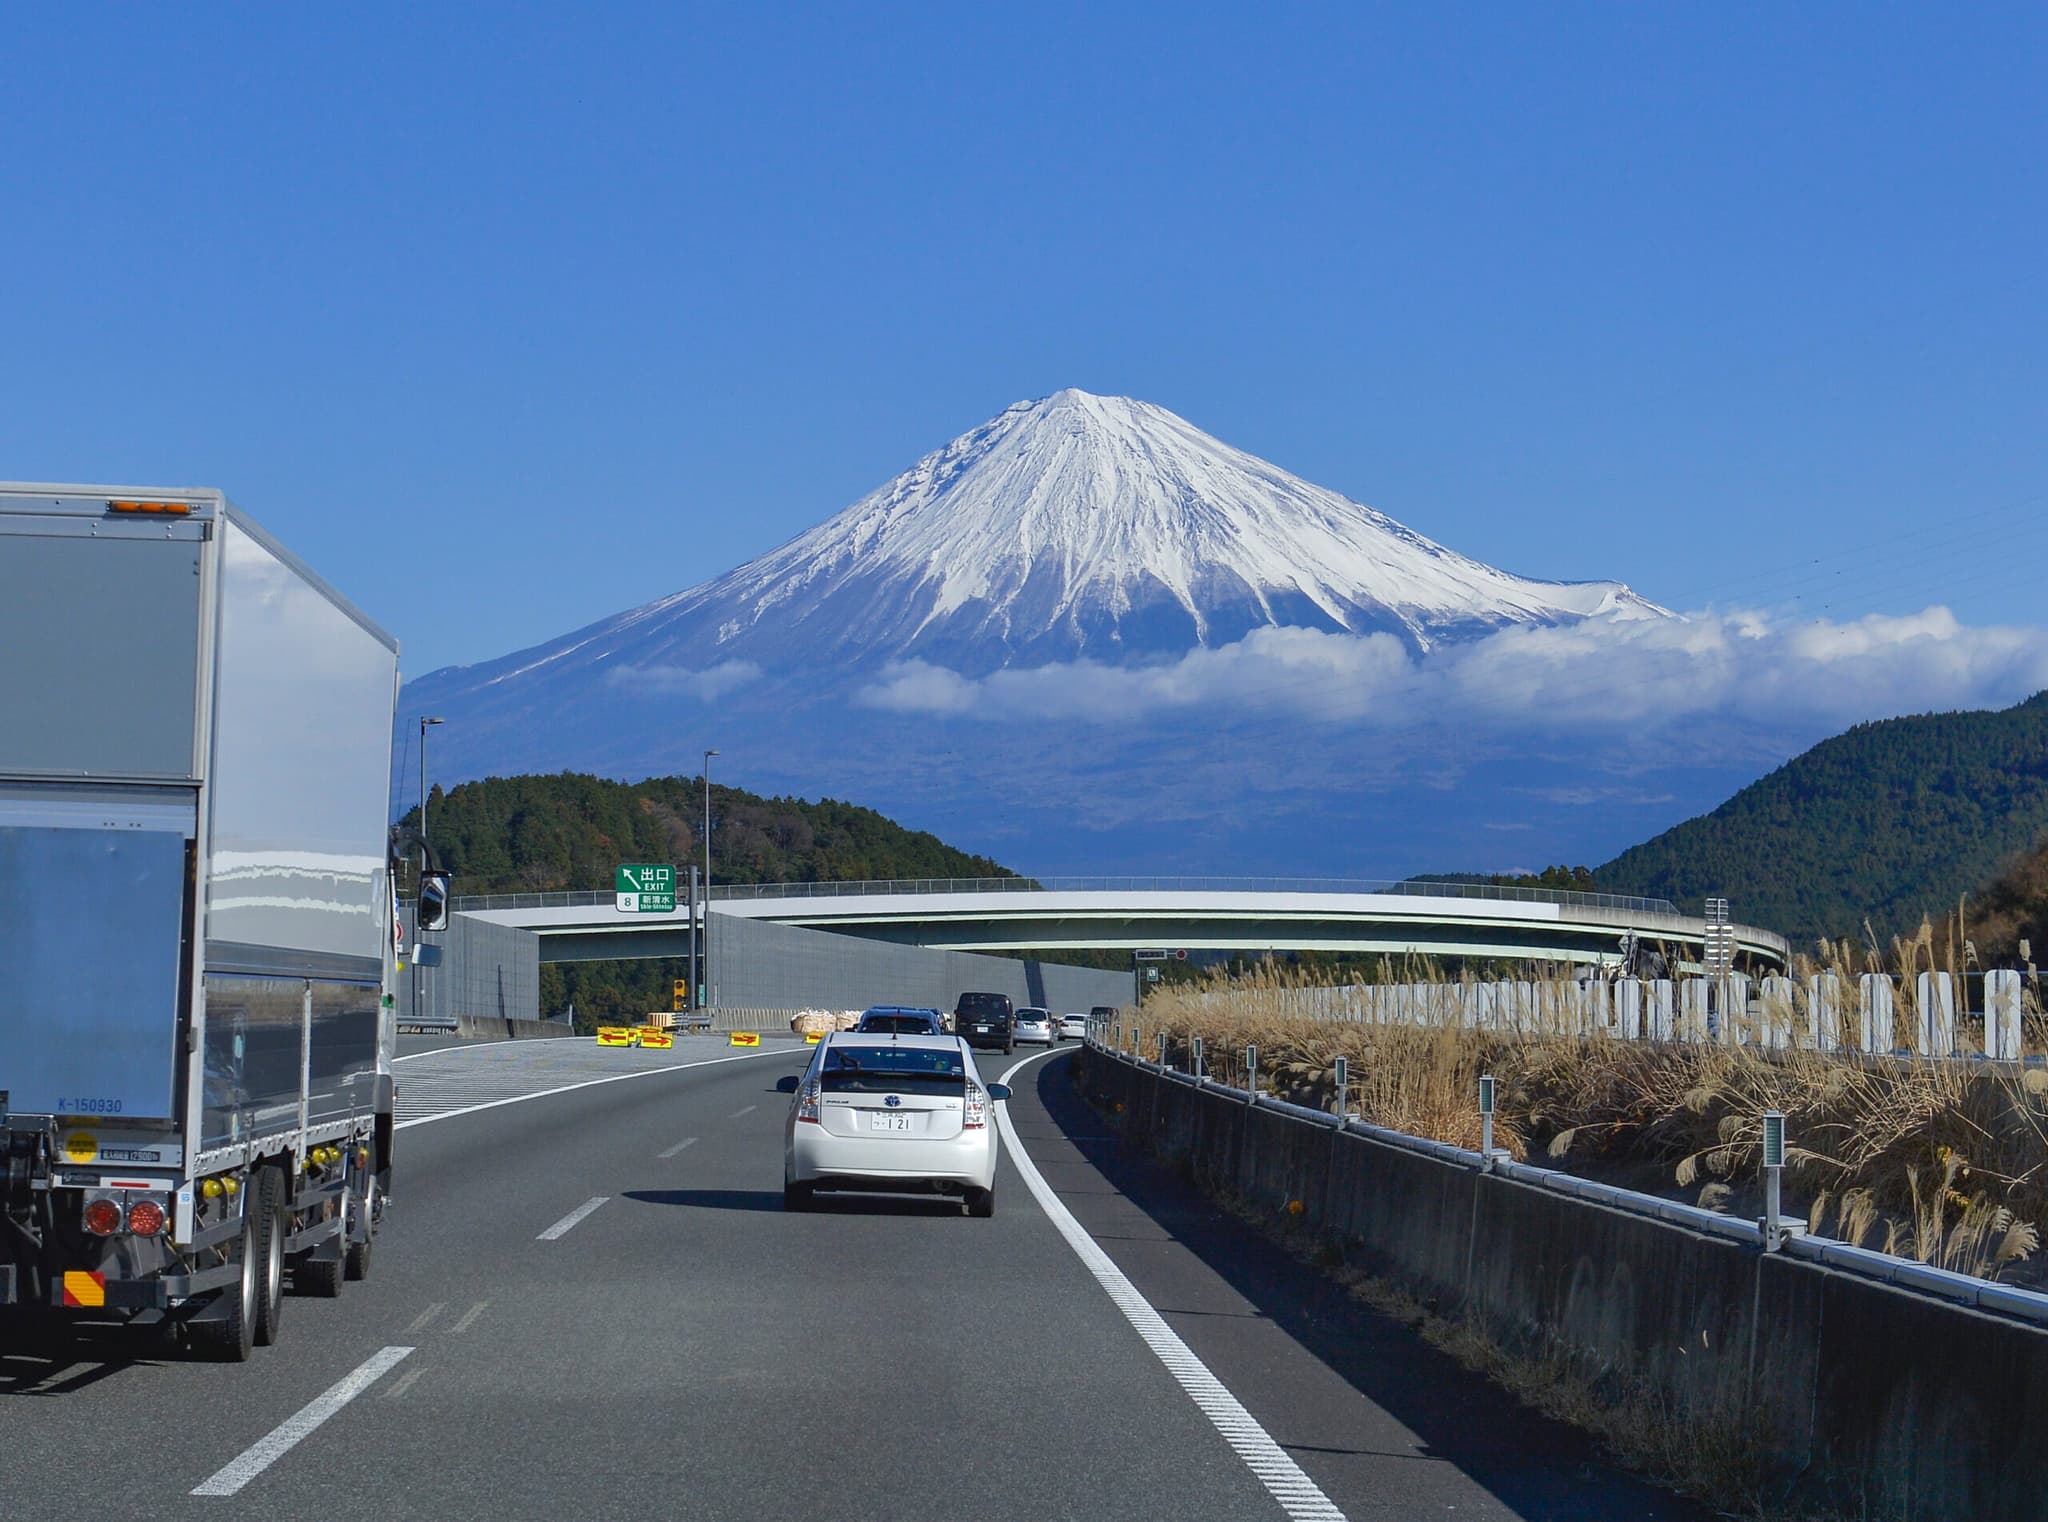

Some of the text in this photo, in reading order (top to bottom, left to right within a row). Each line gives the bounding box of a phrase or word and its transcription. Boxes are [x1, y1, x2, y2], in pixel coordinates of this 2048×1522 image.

[641, 868, 669, 881] 出口
[645, 883, 665, 891] EXIT
[625, 897, 632, 907] 8
[58, 1098, 122, 1112] K-150930
